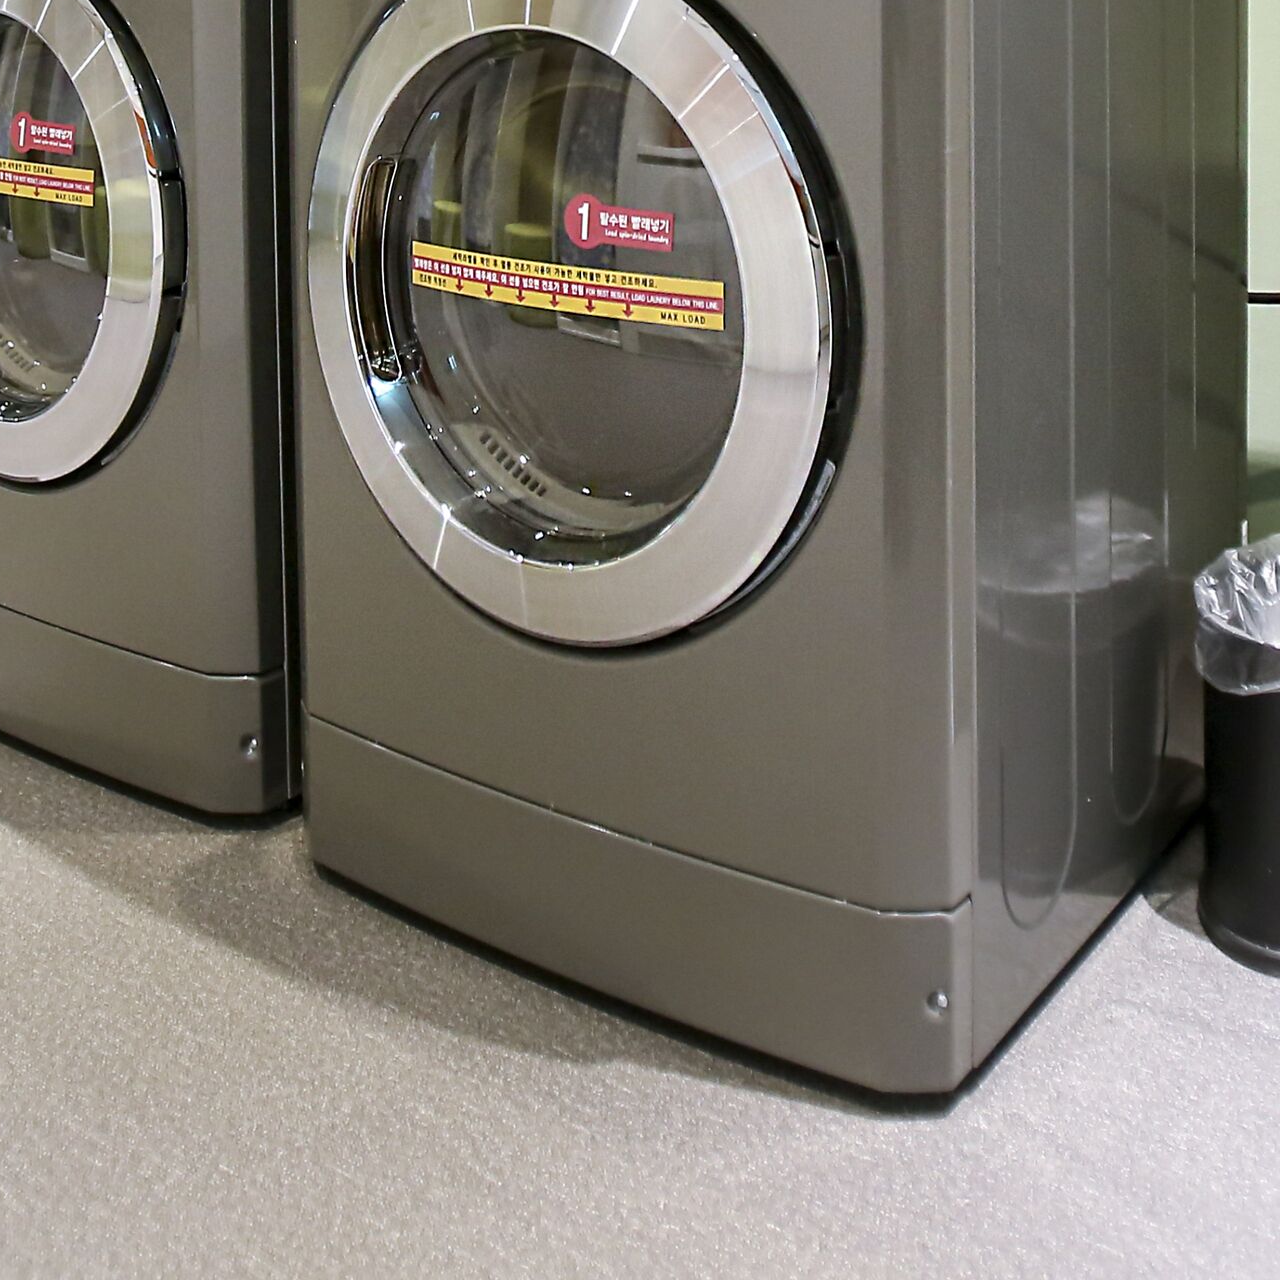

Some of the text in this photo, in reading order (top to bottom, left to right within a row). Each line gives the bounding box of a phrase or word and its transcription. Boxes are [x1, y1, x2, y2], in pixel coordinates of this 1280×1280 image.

[18, 118, 26, 146] 1
[577, 202, 669, 241] 1 탈수된 빨래넣기
[661, 312, 706, 325] MAX LOAD
